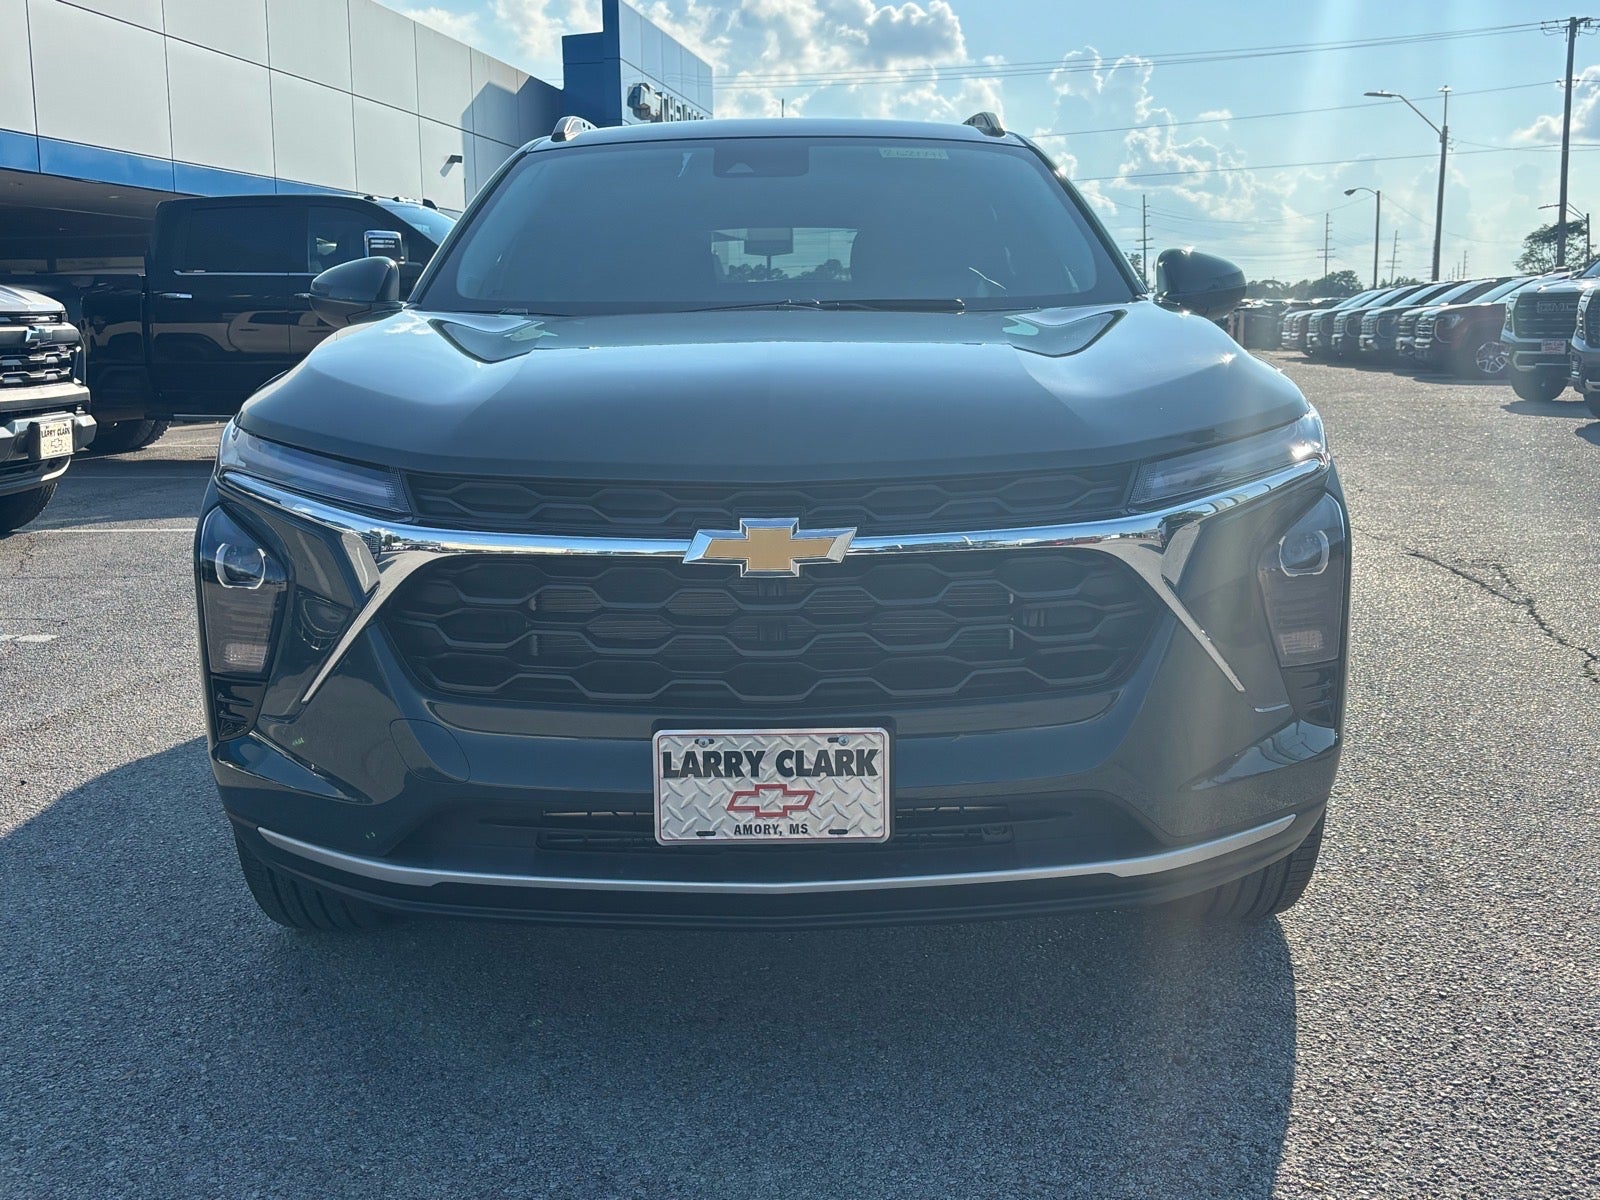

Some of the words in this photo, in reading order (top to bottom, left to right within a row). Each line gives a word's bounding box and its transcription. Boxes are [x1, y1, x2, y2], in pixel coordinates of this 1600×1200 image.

[662, 750, 766, 778] LARRY
[775, 749, 878, 777] CLARK
[733, 823, 783, 836] AMORY,
[789, 823, 809, 835] MS
